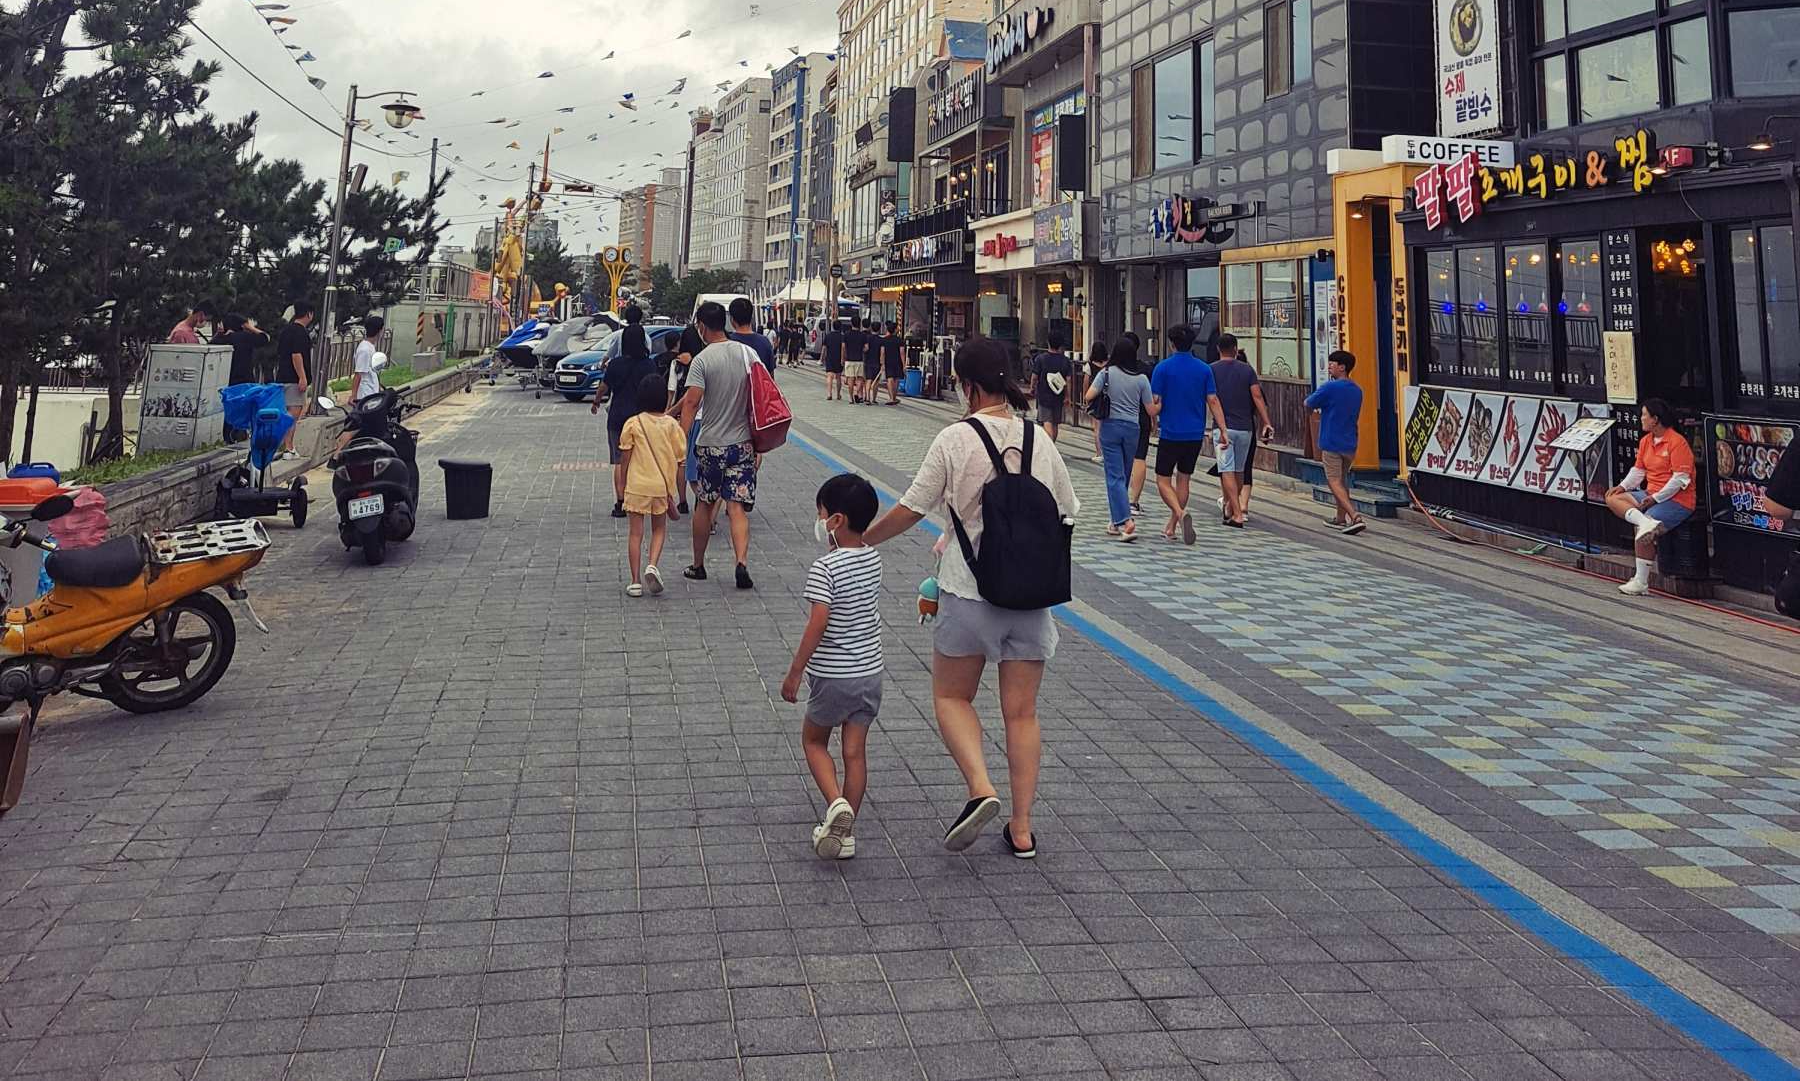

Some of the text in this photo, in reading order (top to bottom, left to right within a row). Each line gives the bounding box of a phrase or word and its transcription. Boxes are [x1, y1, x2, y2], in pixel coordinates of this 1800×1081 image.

[1445, 70, 1465, 98] 수제
[1456, 89, 1492, 123] 팥빙수
[1420, 142, 1500, 163] COFFEE
[1415, 129, 1653, 231] 팔팔 조개구이 & 찜
[1608, 234, 1629, 245] 랍스타
[1741, 383, 1800, 399] 무한리필 조개전골
[1490, 464, 1511, 481] 랍스타
